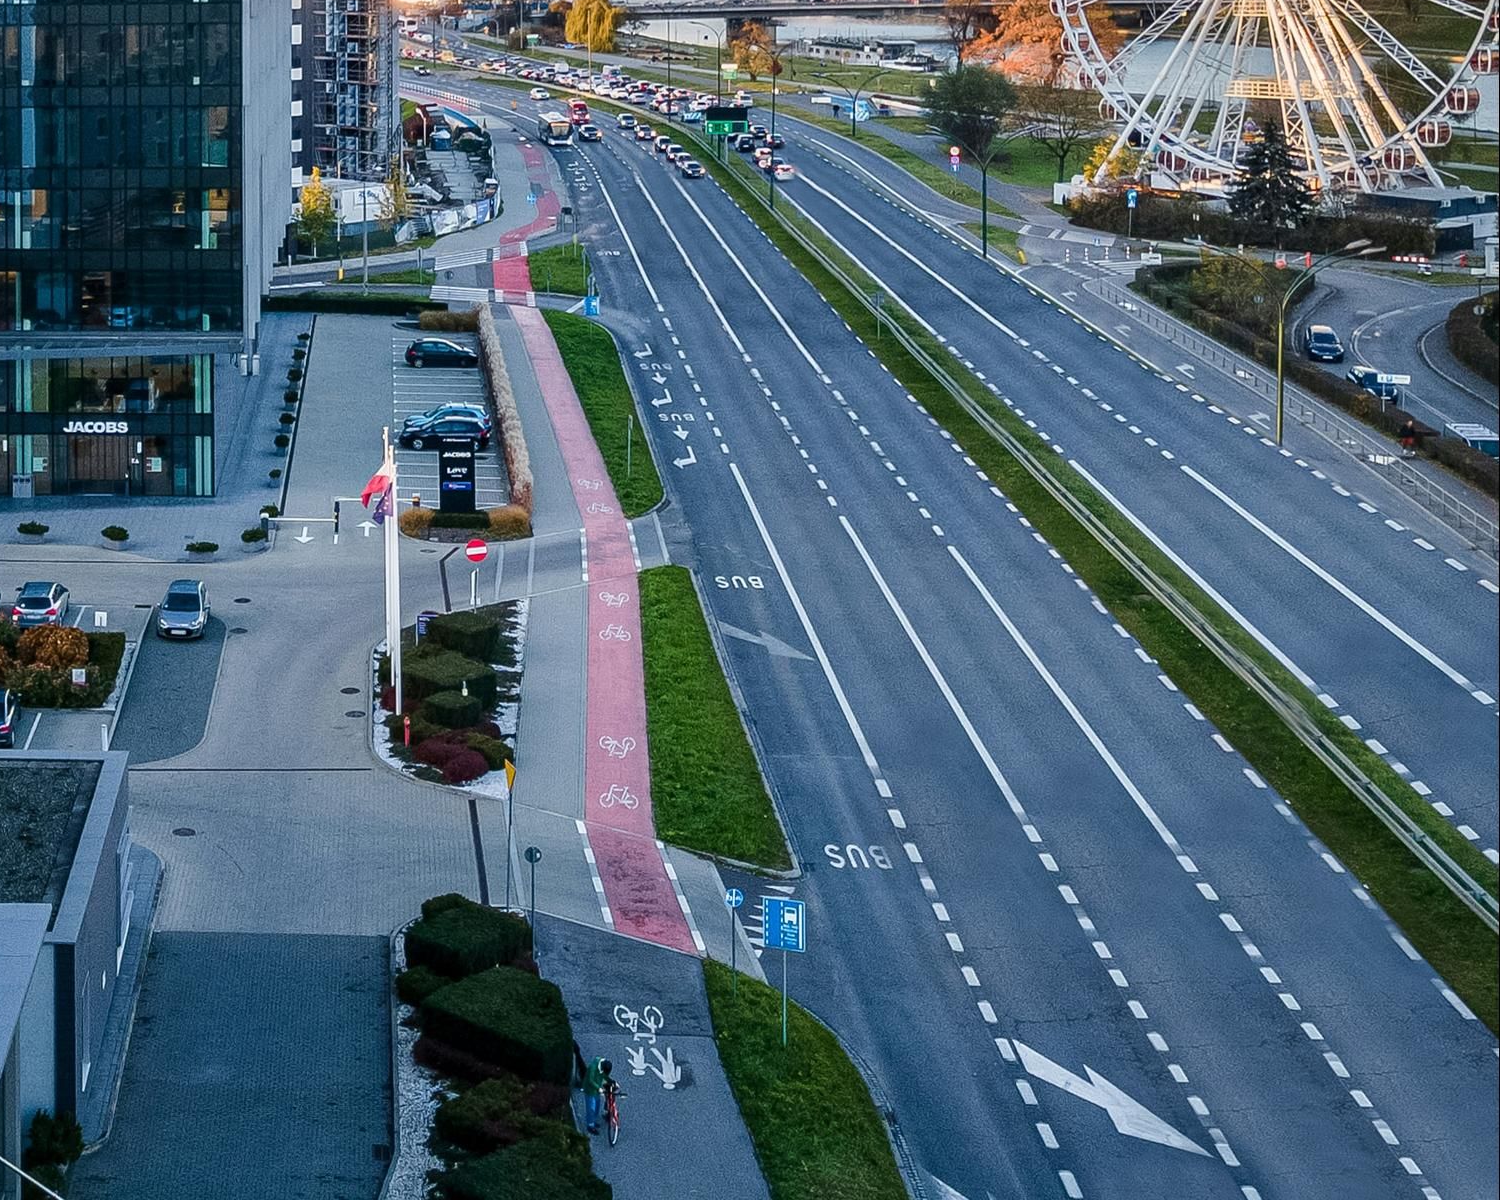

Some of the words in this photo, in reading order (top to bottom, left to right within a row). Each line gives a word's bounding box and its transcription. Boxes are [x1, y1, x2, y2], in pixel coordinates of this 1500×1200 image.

[658, 413, 696, 422] BUS
[62, 421, 129, 434] JACOBS
[714, 575, 765, 589] BUS
[823, 844, 893, 869] BUS
